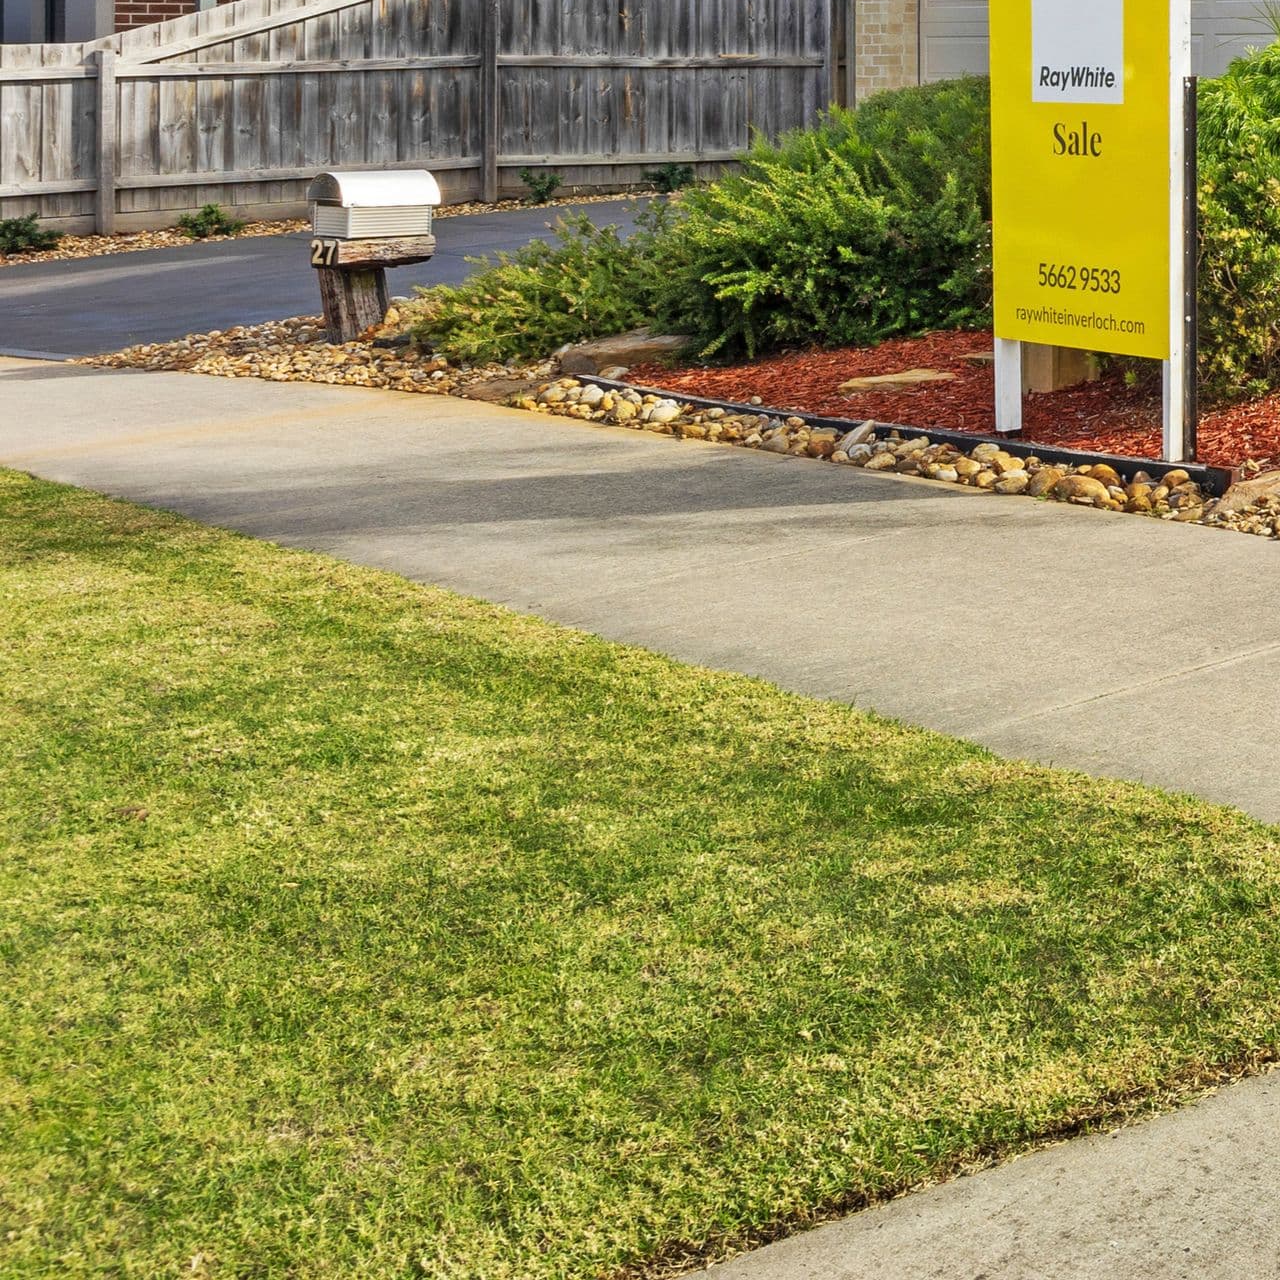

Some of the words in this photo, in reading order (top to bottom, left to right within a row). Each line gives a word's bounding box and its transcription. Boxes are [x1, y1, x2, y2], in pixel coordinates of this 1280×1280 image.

[1053, 121, 1102, 157] Sale
[311, 239, 336, 265] 27
[1039, 263, 1077, 290] 5662
[1080, 267, 1120, 294] 9533
[1016, 306, 1145, 334] raywhiteinverloch.com
